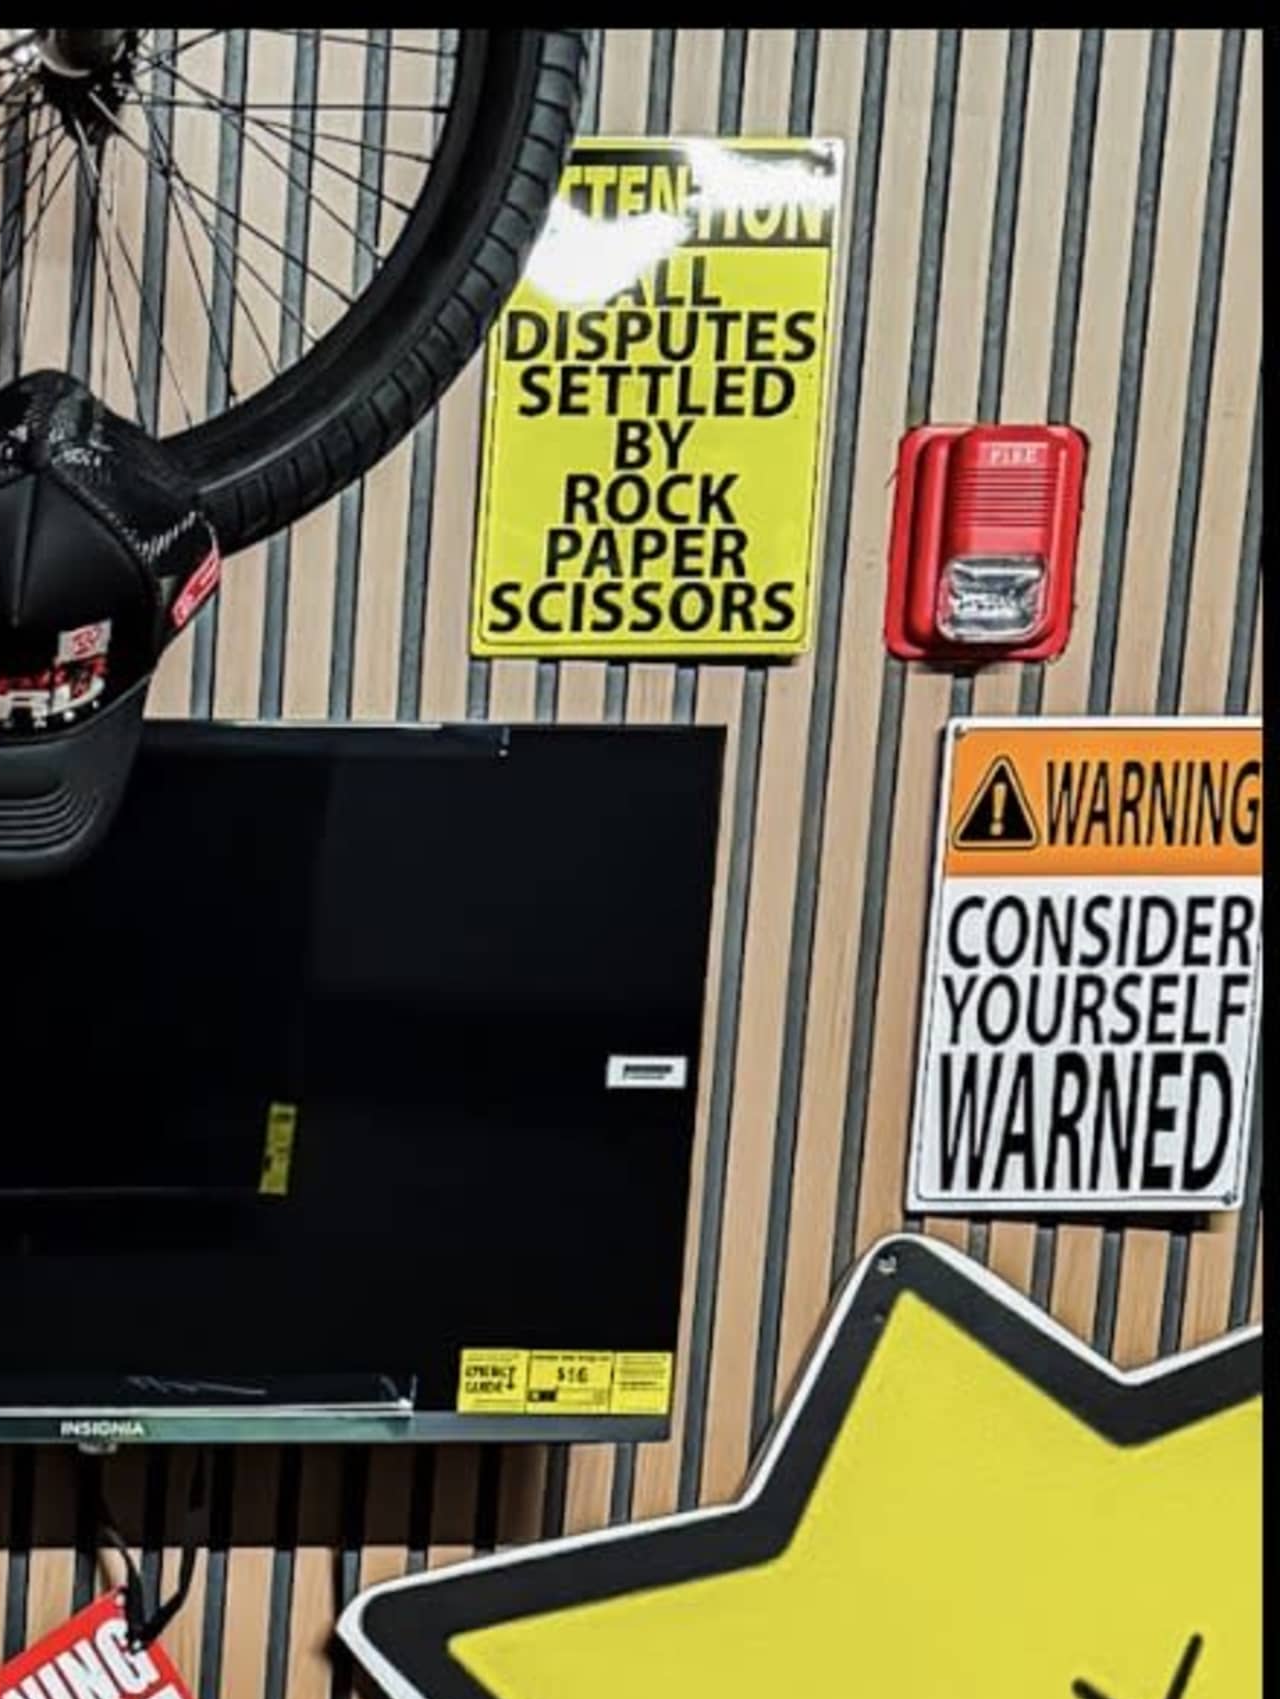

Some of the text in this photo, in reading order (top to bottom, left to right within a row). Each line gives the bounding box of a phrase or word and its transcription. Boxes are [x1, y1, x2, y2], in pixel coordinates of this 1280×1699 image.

[505, 312, 816, 362] DISPUTES
[518, 366, 796, 416] SETTLED
[615, 421, 694, 470] BY
[564, 475, 739, 525] ROCK
[546, 530, 748, 578] PAPER
[489, 583, 796, 633] SCISSORS
[1046, 761, 1262, 847] WARNING
[948, 895, 1255, 968] CONSIDER
[942, 974, 1249, 1046] YOURSELF
[939, 1051, 1233, 1192] WARNED
[60, 1421, 144, 1437] INSIGNIA
